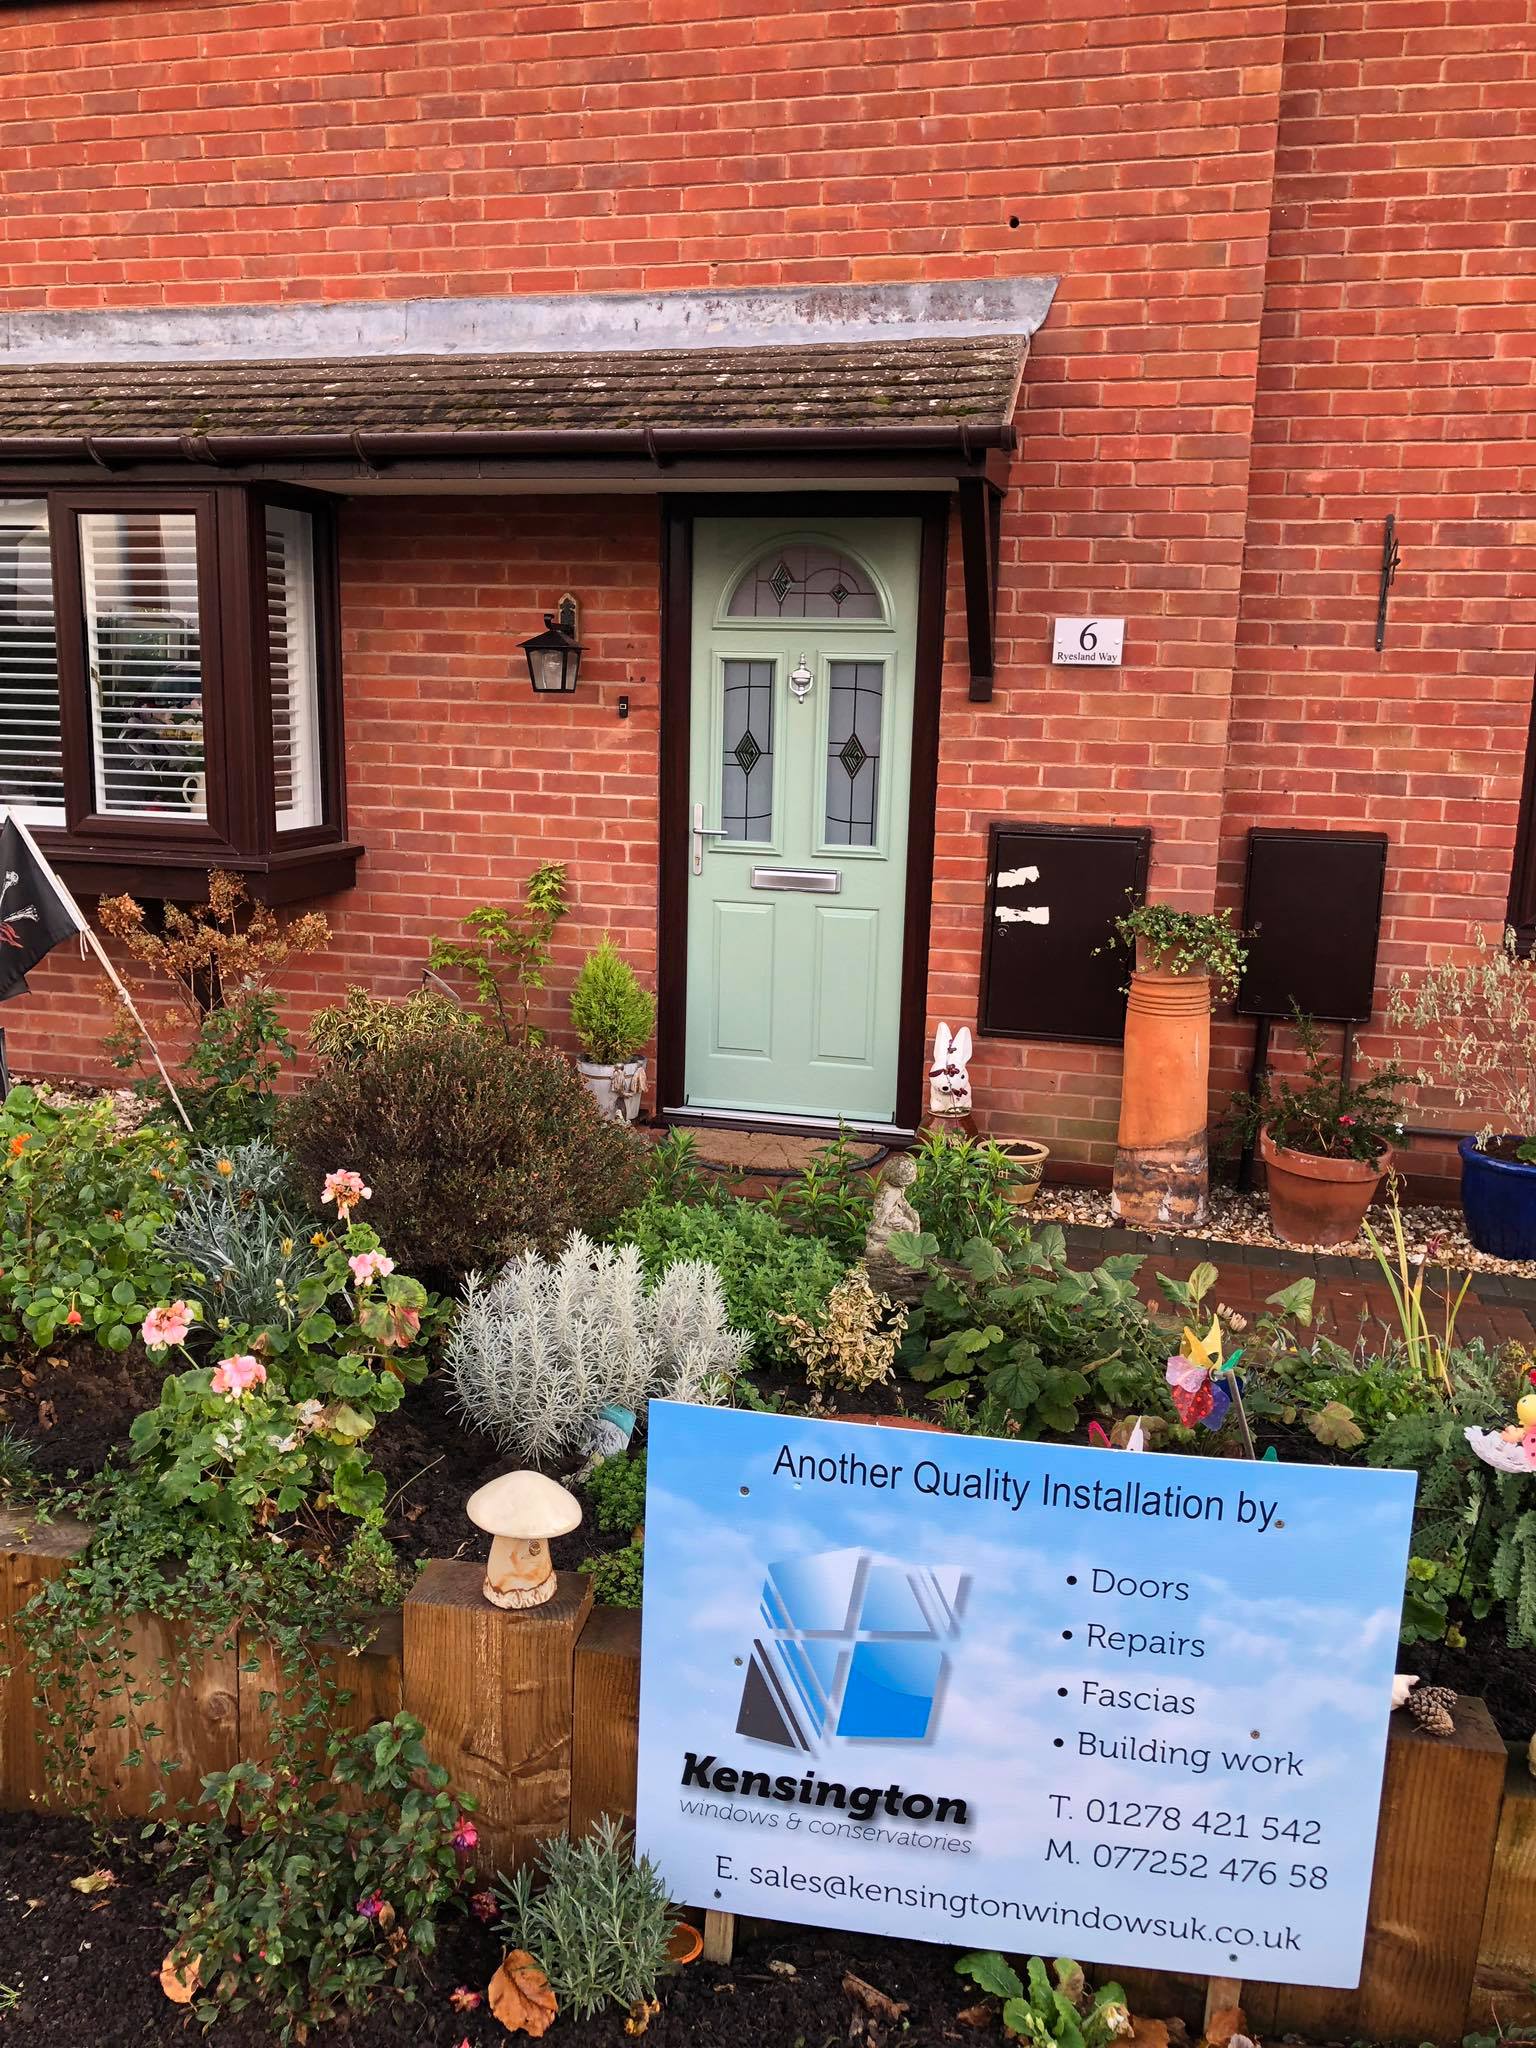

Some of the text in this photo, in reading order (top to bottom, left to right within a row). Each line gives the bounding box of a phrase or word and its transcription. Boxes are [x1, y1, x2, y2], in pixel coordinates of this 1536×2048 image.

[1057, 651, 1118, 663] Ryesland Way
[1080, 622, 1098, 651] 6
[773, 1445, 1278, 1532] Another Quality Installation by
[1092, 1569, 1188, 1600] Doors
[1088, 1624, 1204, 1657] Repairs
[1083, 1681, 1195, 1714] Fascias
[1078, 1731, 1303, 1776] Building work
[681, 1752, 968, 1825] Kensington
[680, 1798, 973, 1853] windows & conservatories
[1049, 1794, 1320, 1844] T. 01278 421 542
[1045, 1839, 1327, 1890] M. 077252 476 58
[716, 1855, 1301, 1951] E. sales@kensingtonwindowsuk.co.uk
